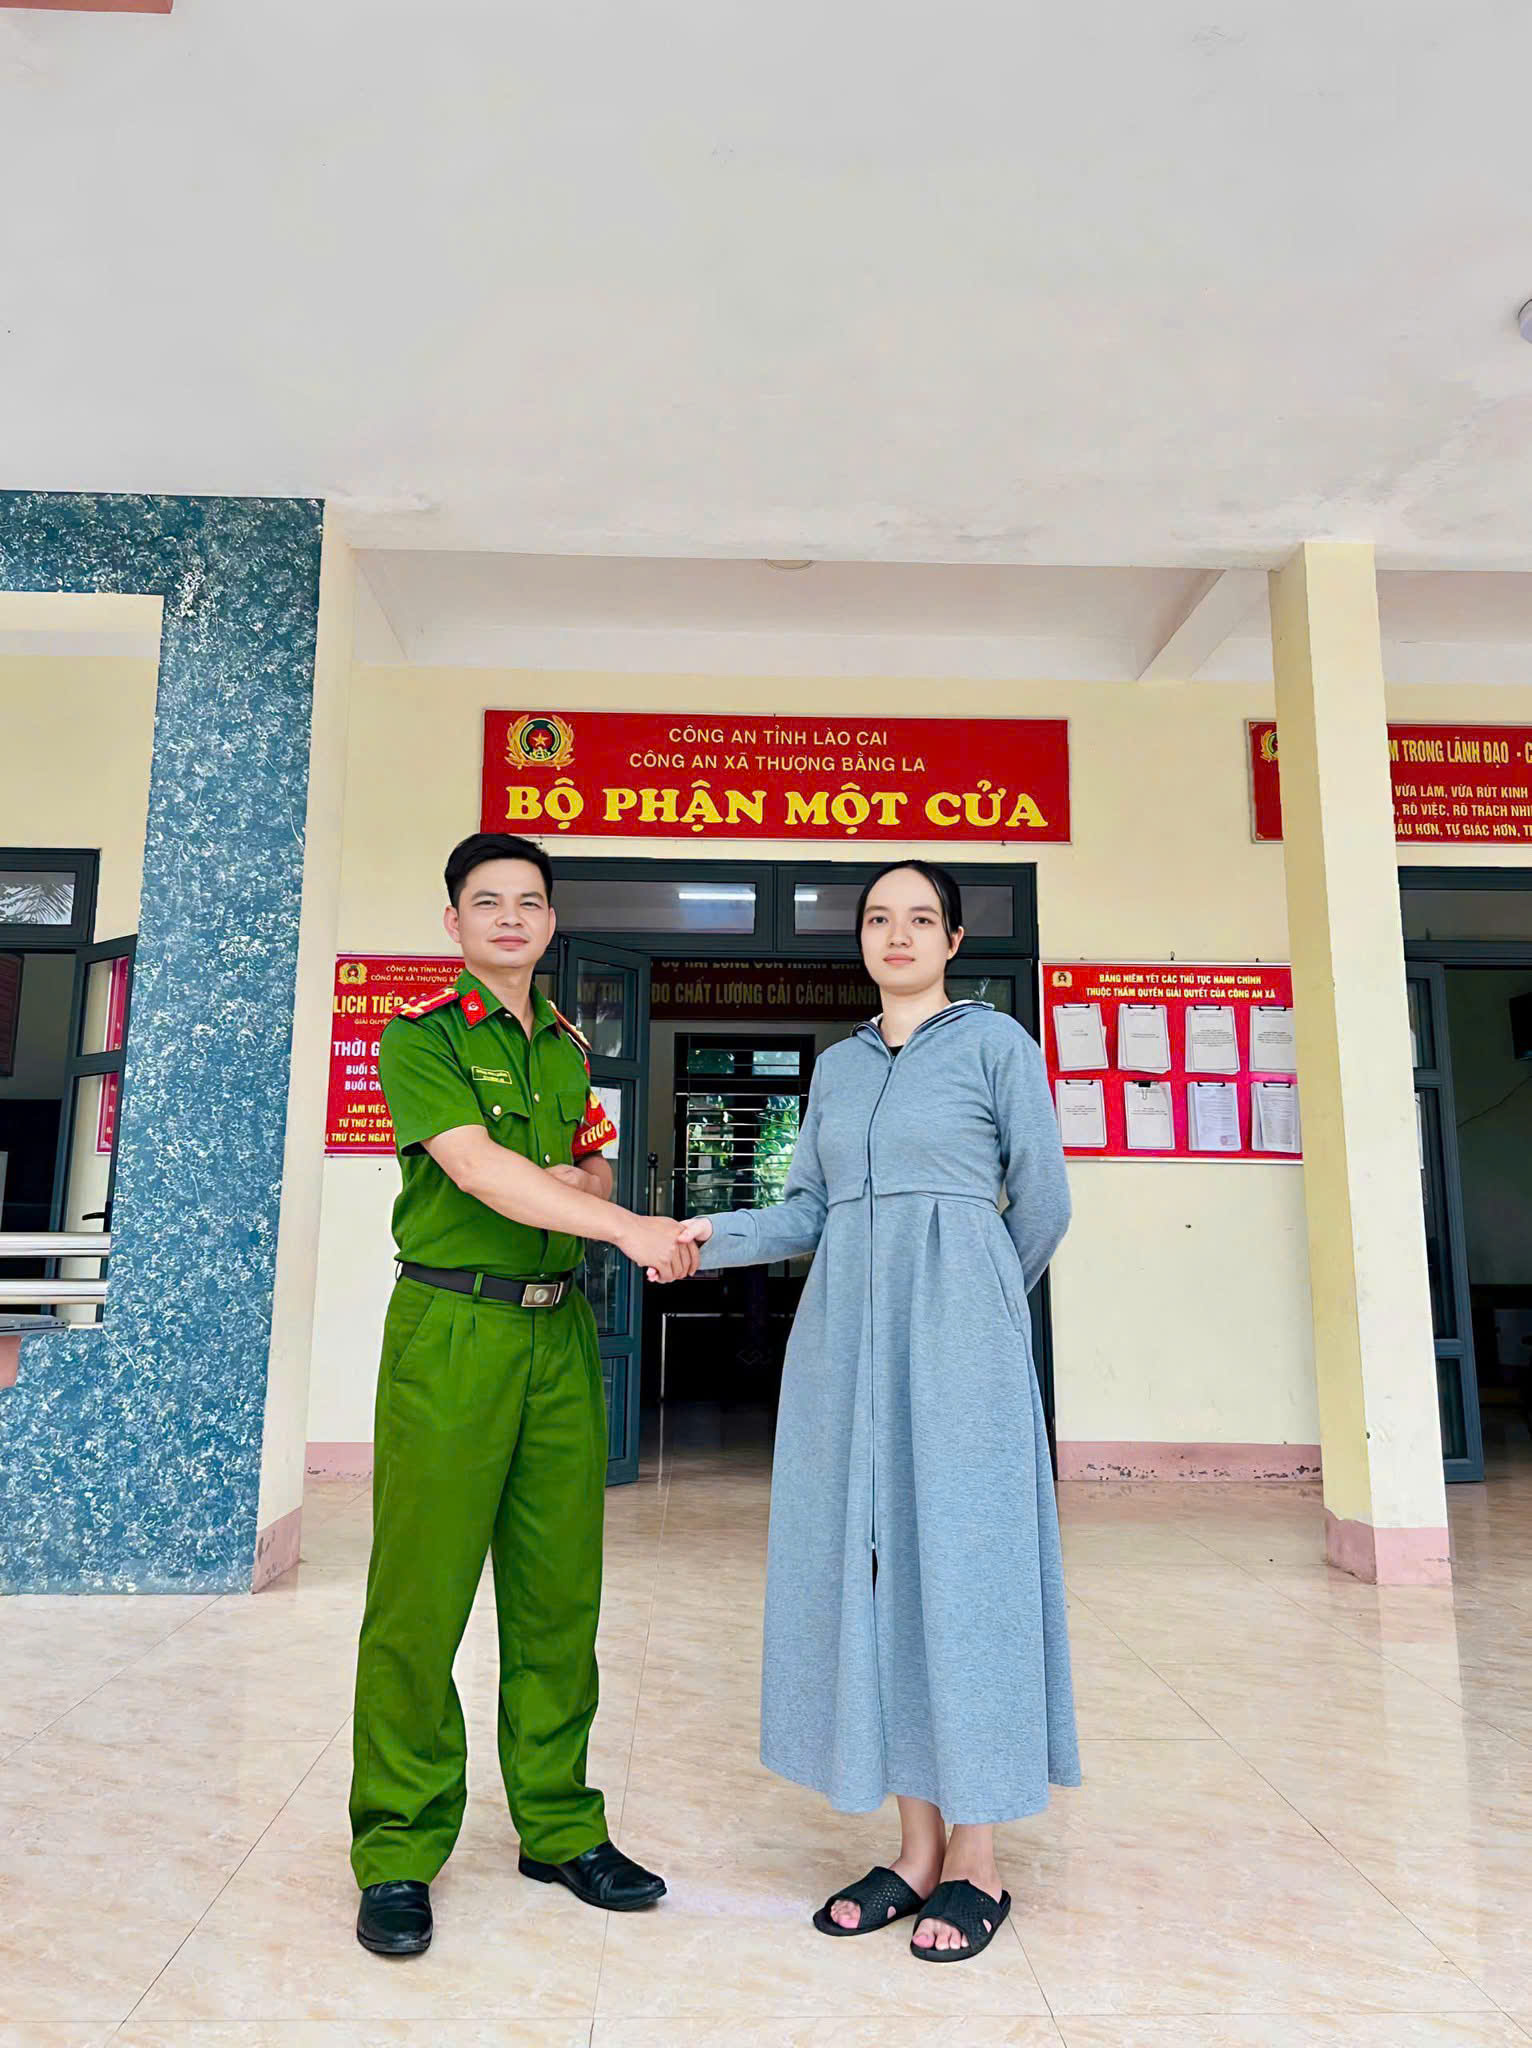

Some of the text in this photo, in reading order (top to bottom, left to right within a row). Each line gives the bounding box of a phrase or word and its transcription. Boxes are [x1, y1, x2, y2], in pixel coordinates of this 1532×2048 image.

[669, 724, 888, 746] CÔNG AN TỈNH LÀO CAI
[1402, 739, 1445, 762] TRONG
[1447, 736, 1481, 763] LÃNH
[1483, 741, 1509, 768] ĐẠO
[629, 750, 926, 774] CÔNG AN XÃ THƯỢNG BẰNG LA
[1451, 784, 1474, 798] VỪA
[1476, 783, 1498, 798] RÚT
[1500, 786, 1529, 799] KINH
[505, 777, 1050, 838] BỘ PHẬN MỘT CỬA
[1471, 802, 1508, 817] TRÁCH
[1463, 821, 1490, 836] GIÁC
[386, 965, 406, 973] CÔNG
[420, 964, 437, 973] TỈNH
[438, 966, 452, 974] LÀO
[1161, 973, 1178, 984] CÁC
[674, 976, 712, 1004] CHẤT
[715, 980, 763, 1009] LƯỢNG
[767, 976, 791, 1005] CẢI
[795, 979, 833, 1005] CÁCH
[1251, 989, 1263, 998] AN
[333, 990, 404, 1017] LỊCH TIẾP
[333, 1037, 367, 1057] THỜI
[347, 1103, 365, 1114] LÀM
[368, 1119, 375, 1128] 2
[349, 1132, 366, 1143] CÁC
